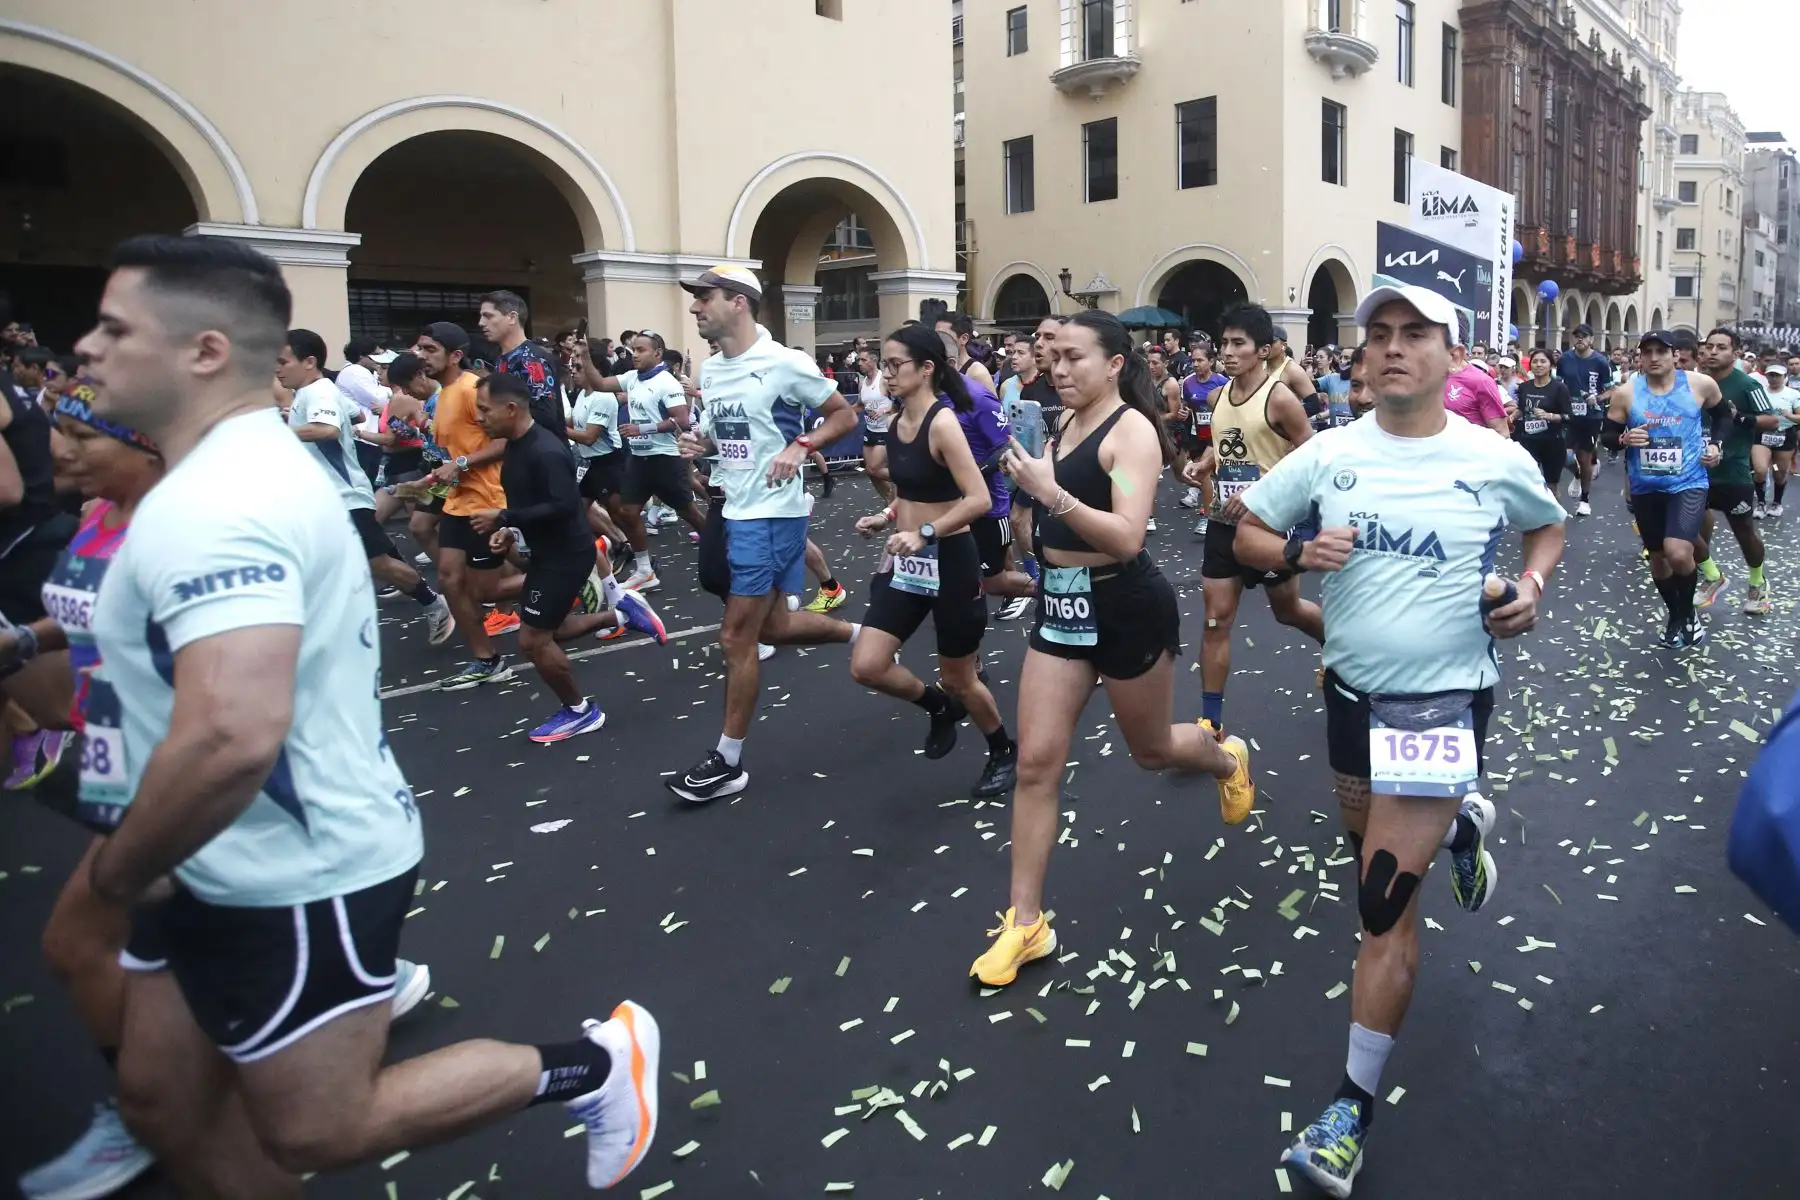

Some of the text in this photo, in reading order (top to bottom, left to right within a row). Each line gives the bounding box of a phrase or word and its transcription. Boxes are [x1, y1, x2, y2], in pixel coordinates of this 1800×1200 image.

[1422, 194, 1479, 216] LIMA
[1500, 203, 1509, 256] CALLE
[1384, 249, 1440, 268] KIA
[1041, 404, 1067, 412] arathon
[1526, 421, 1545, 430] 5904
[721, 444, 748, 459] 5689
[1645, 452, 1677, 463] 1464
[1348, 511, 1379, 520] KIA
[900, 556, 933, 577] 3071
[171, 563, 286, 602] NITRO
[1044, 594, 1090, 620] 17160
[1384, 734, 1461, 763] 1675
